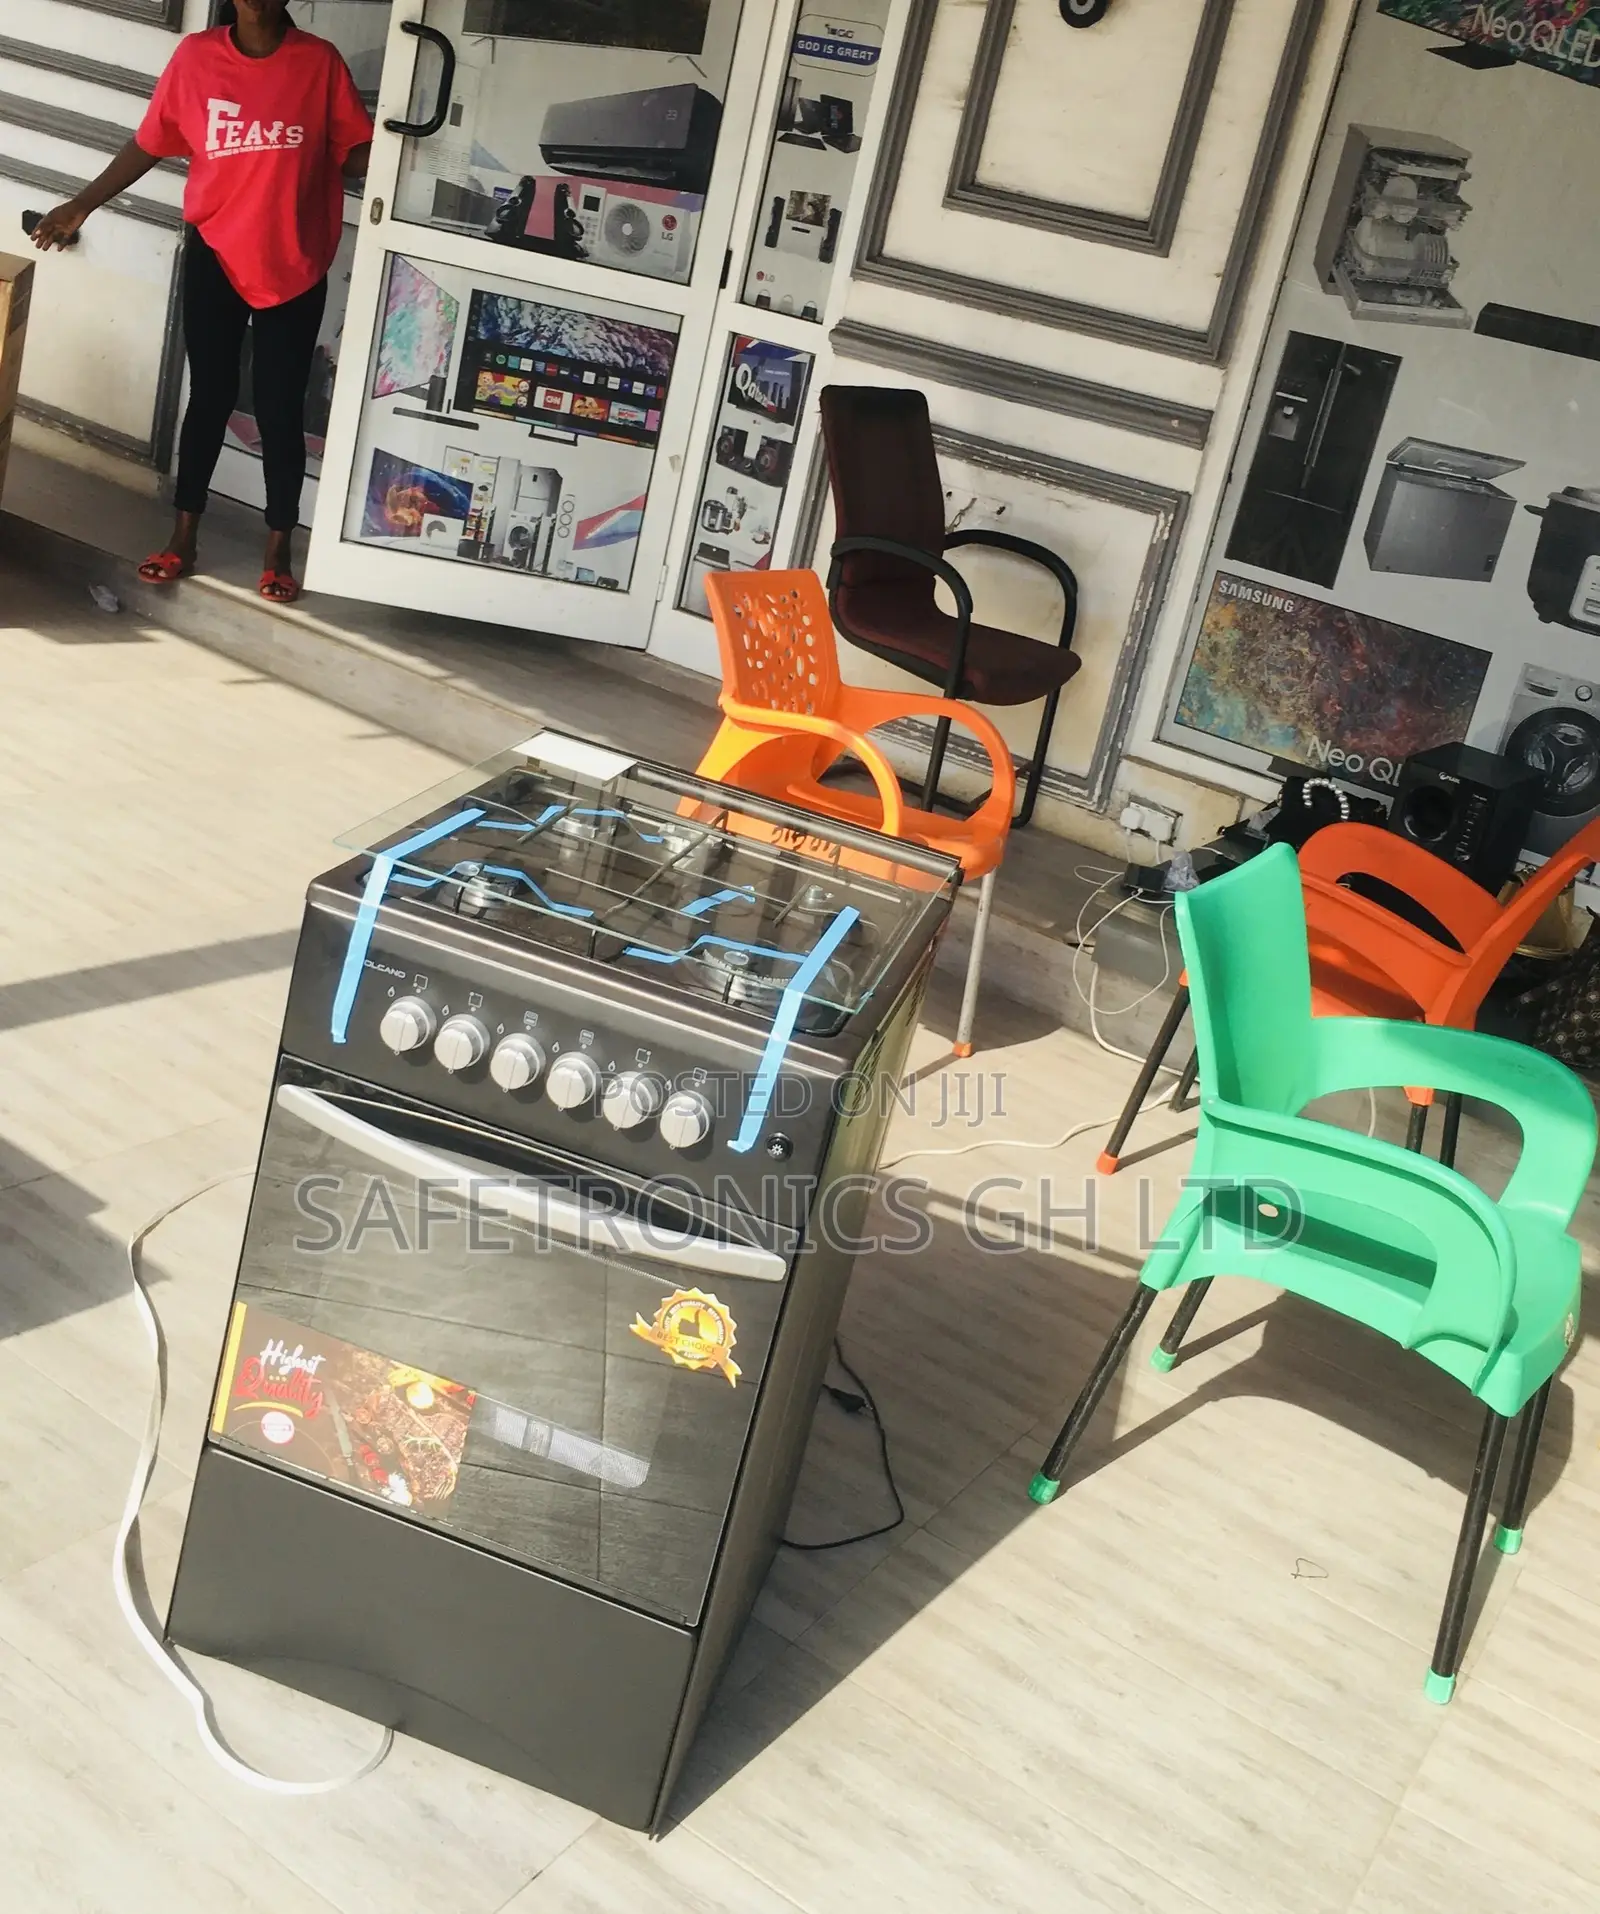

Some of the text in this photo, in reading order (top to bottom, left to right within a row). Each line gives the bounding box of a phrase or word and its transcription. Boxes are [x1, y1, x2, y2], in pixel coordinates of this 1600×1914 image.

[1469, 3, 1600, 68] Neo QLED
[797, 40, 874, 61] GOD IS GREAT
[661, 231, 674, 242] LG
[1219, 580, 1294, 613] SAMSUNG
[1307, 735, 1402, 787] Neo QL
[364, 959, 406, 979] OLCANO
[656, 1331, 680, 1345] BEST
[681, 1339, 716, 1355] CHOICE
